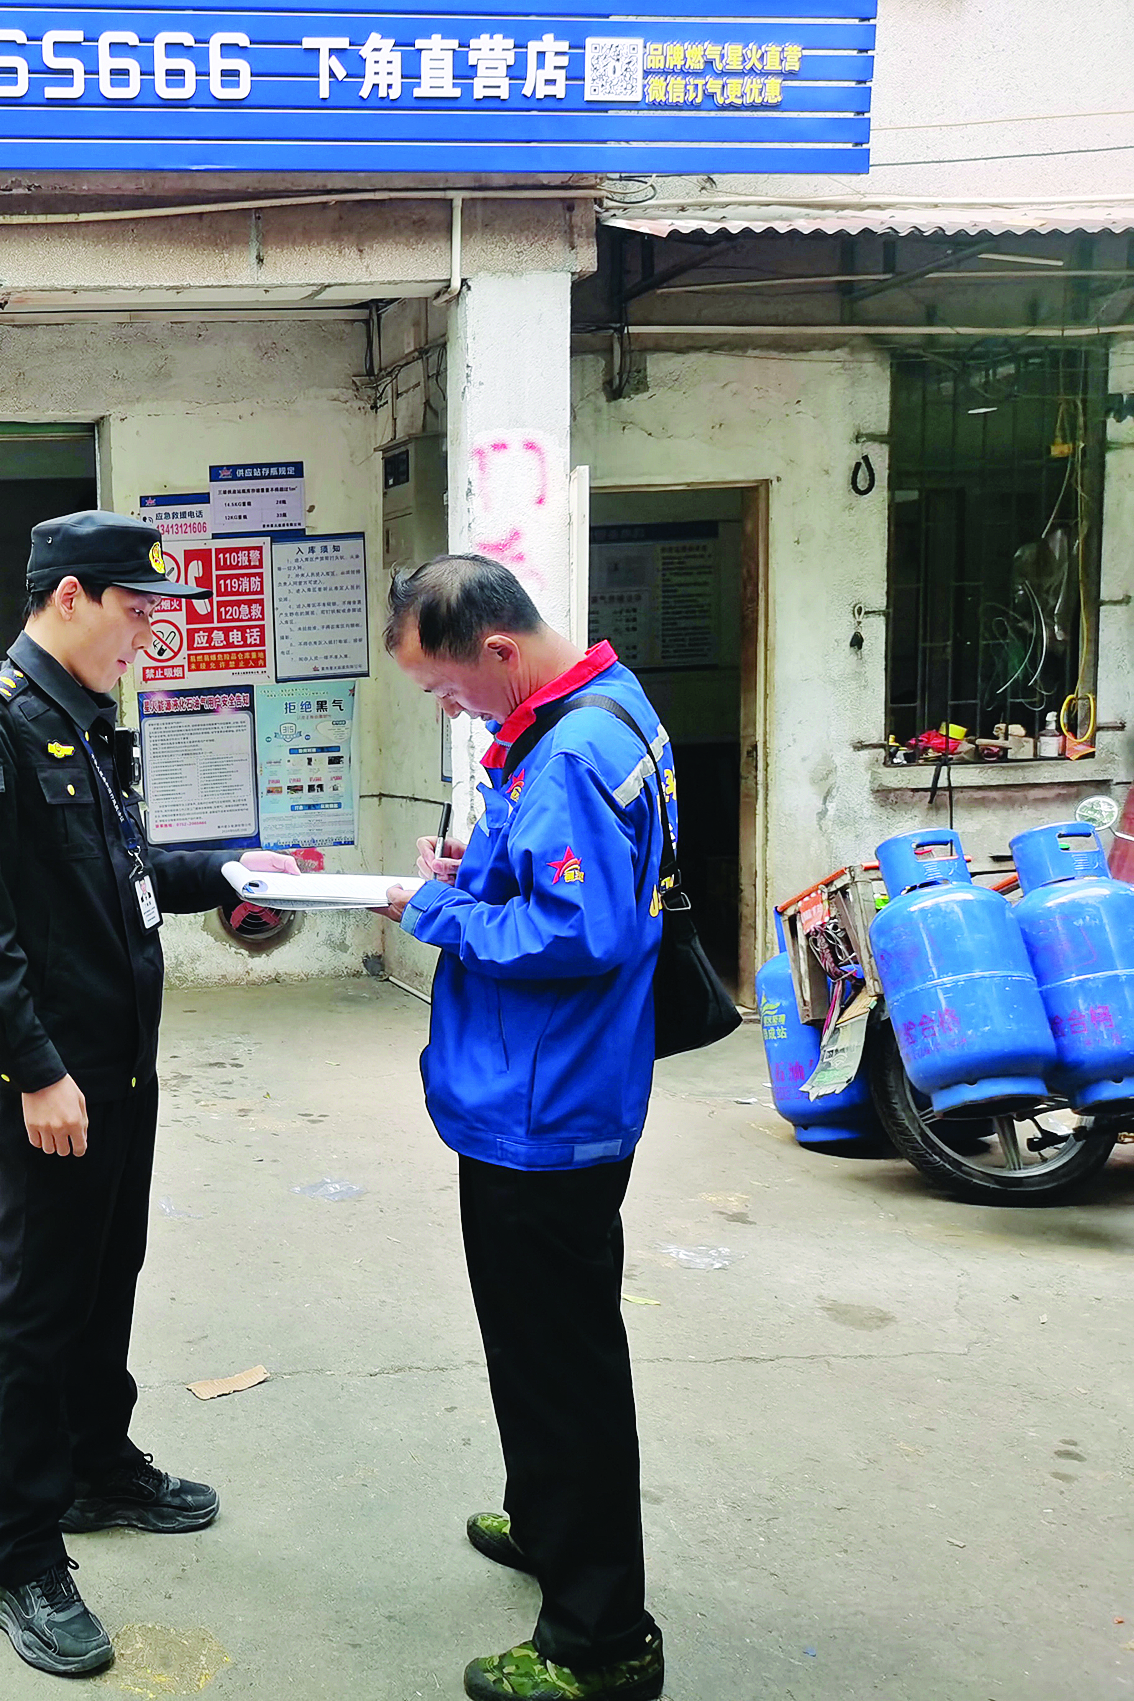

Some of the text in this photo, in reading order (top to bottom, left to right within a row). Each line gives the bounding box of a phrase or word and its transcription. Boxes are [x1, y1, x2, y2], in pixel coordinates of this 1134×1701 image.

[646, 42, 802, 72] 品牌燃气星火直营
[302, 33, 570, 100] 下角直营店
[646, 76, 783, 105] 微信订气更优惠
[155, 510, 204, 521] 应急救援电话
[218, 549, 261, 566] 110报警
[296, 545, 341, 555] 入库须知
[219, 576, 261, 592] 119消防
[220, 603, 262, 620] 120急救
[194, 627, 261, 648] 应急电话
[145, 667, 183, 679] 禁止吸烟
[284, 699, 344, 714] 拒绝黑气
